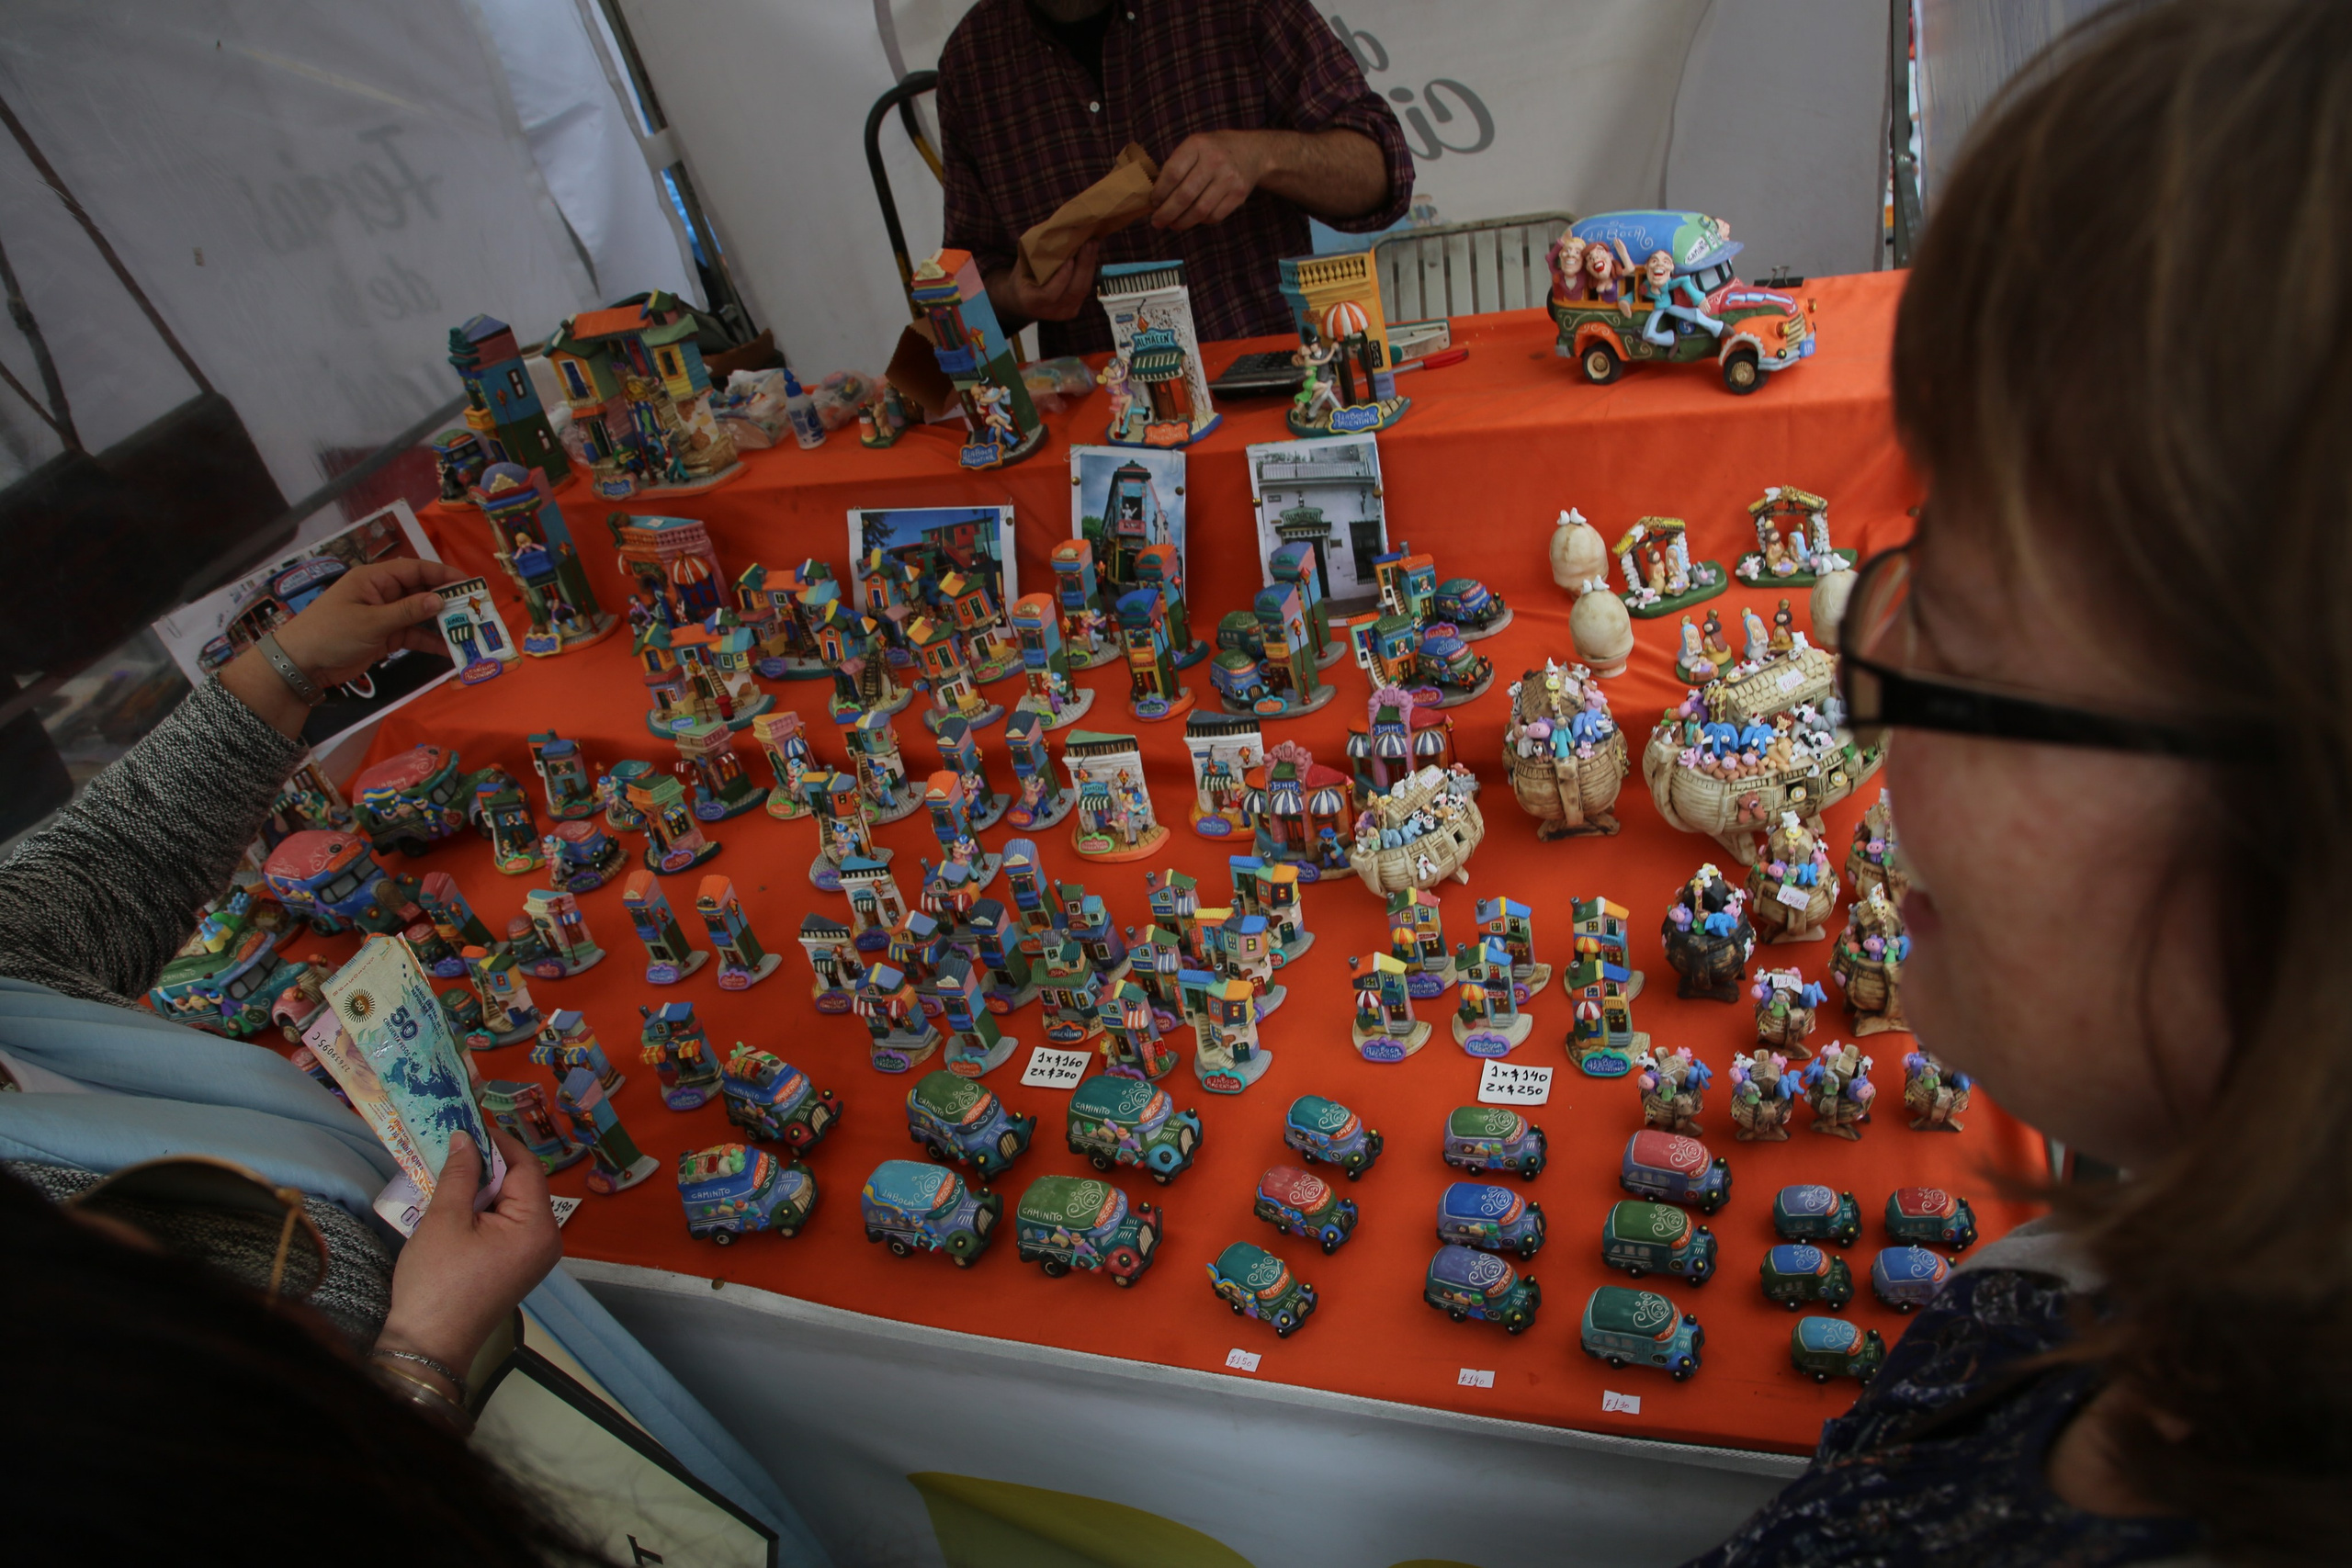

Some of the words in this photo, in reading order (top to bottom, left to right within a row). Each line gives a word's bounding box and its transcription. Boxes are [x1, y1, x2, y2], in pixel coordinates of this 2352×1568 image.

[355, 1000, 366, 1012] 50
[390, 1006, 418, 1041] 50
[919, 1097, 944, 1117] CAMINITO
[1075, 1102, 1111, 1115] CAMINITO
[692, 1188, 731, 1200] CAMINITO
[1023, 1208, 1063, 1221] CAMINITO
